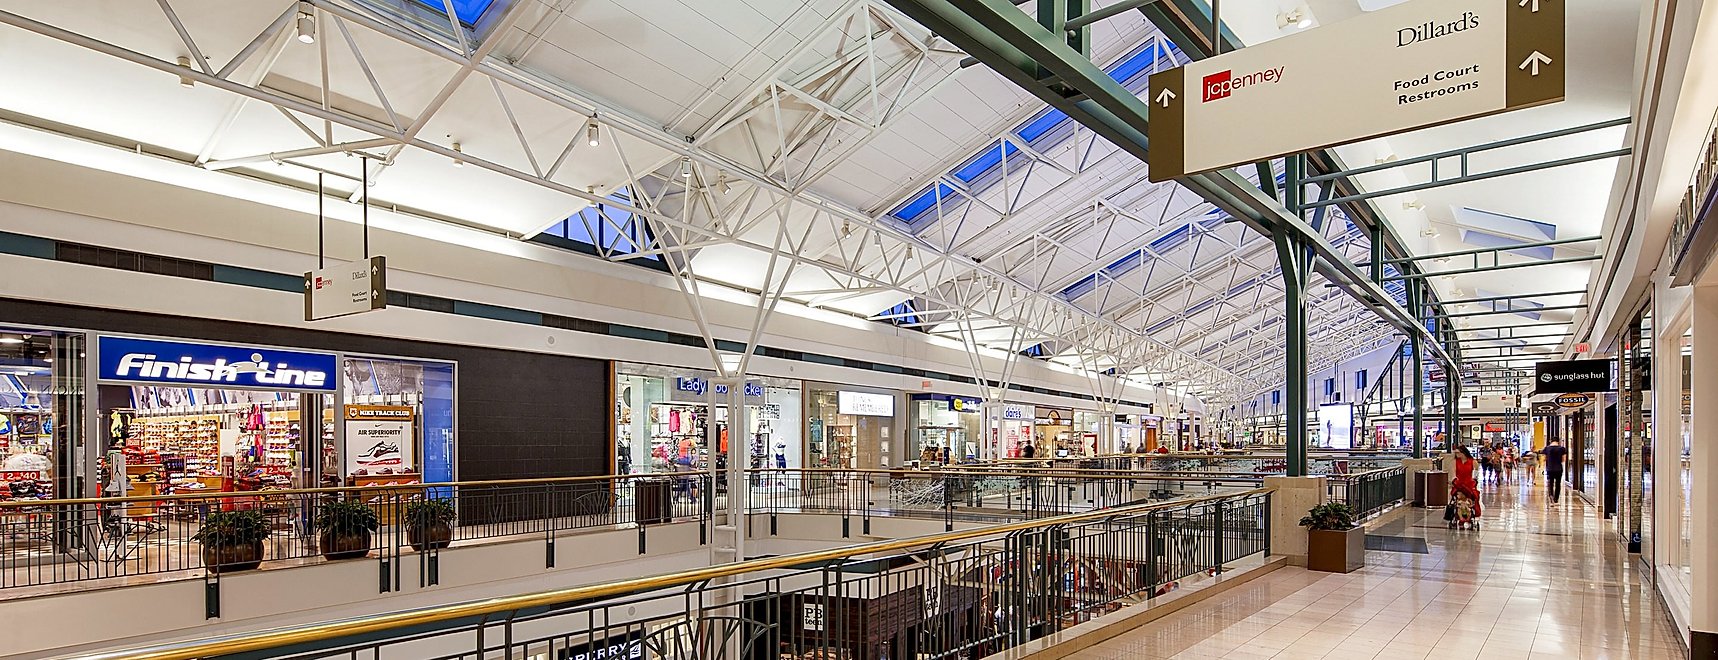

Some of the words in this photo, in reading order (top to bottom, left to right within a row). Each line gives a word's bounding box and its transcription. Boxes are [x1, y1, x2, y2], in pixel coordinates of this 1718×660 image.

[1396, 12, 1480, 48] Dillard's
[1205, 65, 1285, 101] jcpenney
[1393, 74, 1430, 92] Food
[1433, 63, 1480, 82] Court
[1397, 80, 1480, 106] Restrooms
[115, 352, 238, 382] Finish
[254, 360, 327, 387] Line
[1553, 371, 1590, 382] sunglass
[1590, 371, 1606, 380] hut
[680, 377, 707, 396] Lady
[804, 607, 823, 619] PB
